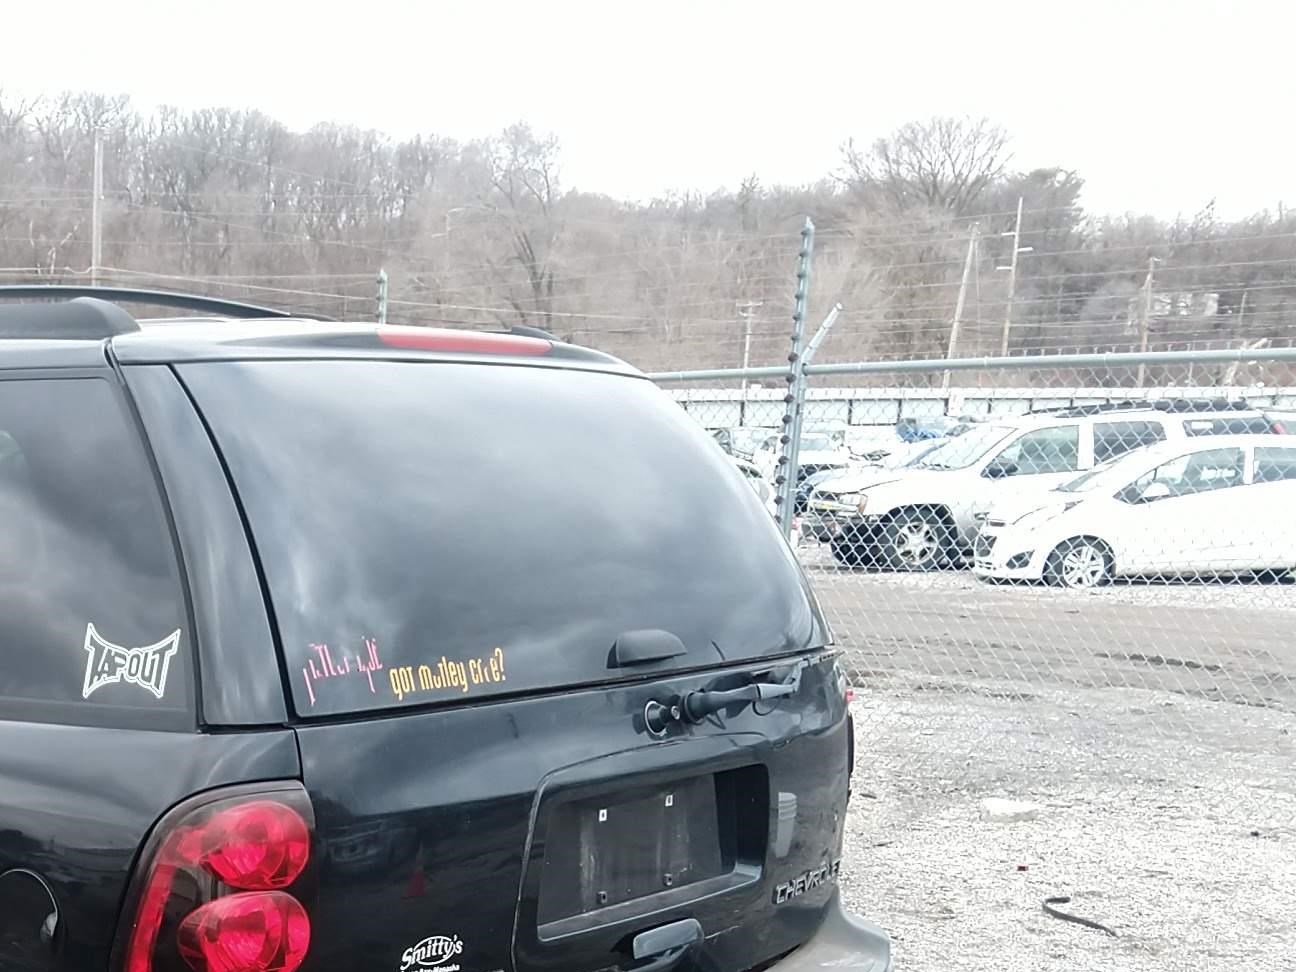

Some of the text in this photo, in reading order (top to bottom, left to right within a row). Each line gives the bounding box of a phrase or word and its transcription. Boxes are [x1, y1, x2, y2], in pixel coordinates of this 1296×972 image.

[82, 622, 181, 699] TAPOUT
[389, 666, 416, 701] got
[399, 934, 464, 971] Smitty's
